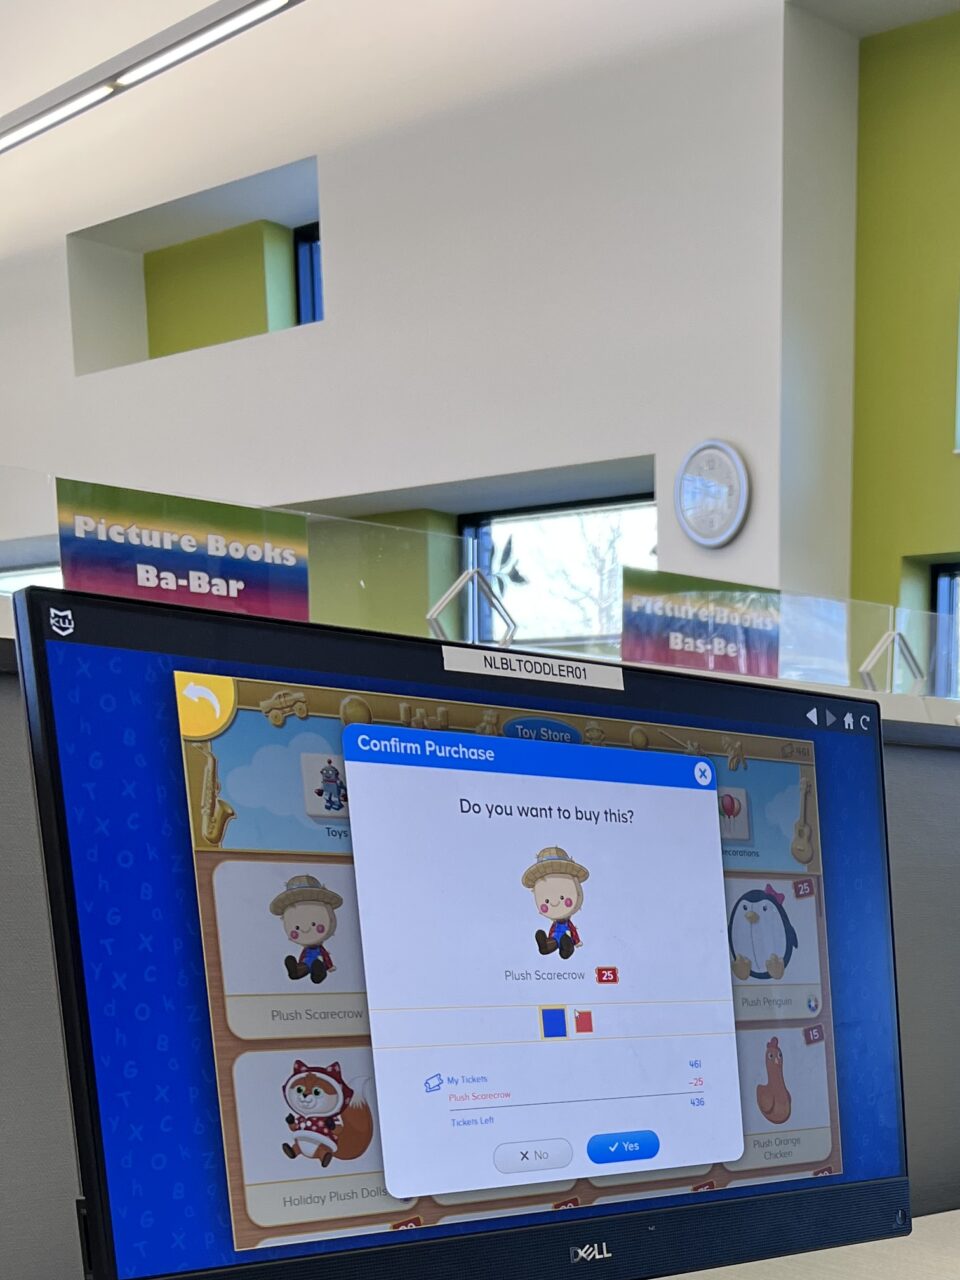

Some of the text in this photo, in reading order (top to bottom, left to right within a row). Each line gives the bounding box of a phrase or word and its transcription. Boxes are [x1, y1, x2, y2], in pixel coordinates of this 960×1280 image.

[74, 515, 298, 567] Picture Books
[136, 563, 245, 598] Ba-Bar
[631, 594, 773, 630] Picture Books
[668, 632, 738, 657] Bas-Be
[483, 655, 588, 681] NLBLTODDLER01
[515, 725, 571, 743] Toy Store
[357, 735, 495, 761] Confirm Purchase
[459, 798, 634, 824] Do you want to buy this?
[325, 826, 349, 840] Toys
[798, 883, 810, 895] 25
[504, 970, 614, 981] Plush Scarecrow 25
[271, 1008, 364, 1021] Plush Scarecrow
[809, 1030, 820, 1041] 15
[447, 1077, 459, 1086] My
[461, 1075, 489, 1084] Tickets
[448, 1093, 470, 1102] Plush
[471, 1091, 511, 1101] Scarecrow
[690, 1097, 705, 1107] 436
[451, 1116, 494, 1127] Tickets Left
[622, 1141, 640, 1152] Yes
[753, 1139, 773, 1149] Plush
[534, 1150, 549, 1161] No
[283, 1186, 388, 1207] Holiday Plush Dolls
[569, 1241, 613, 1264] DELL
